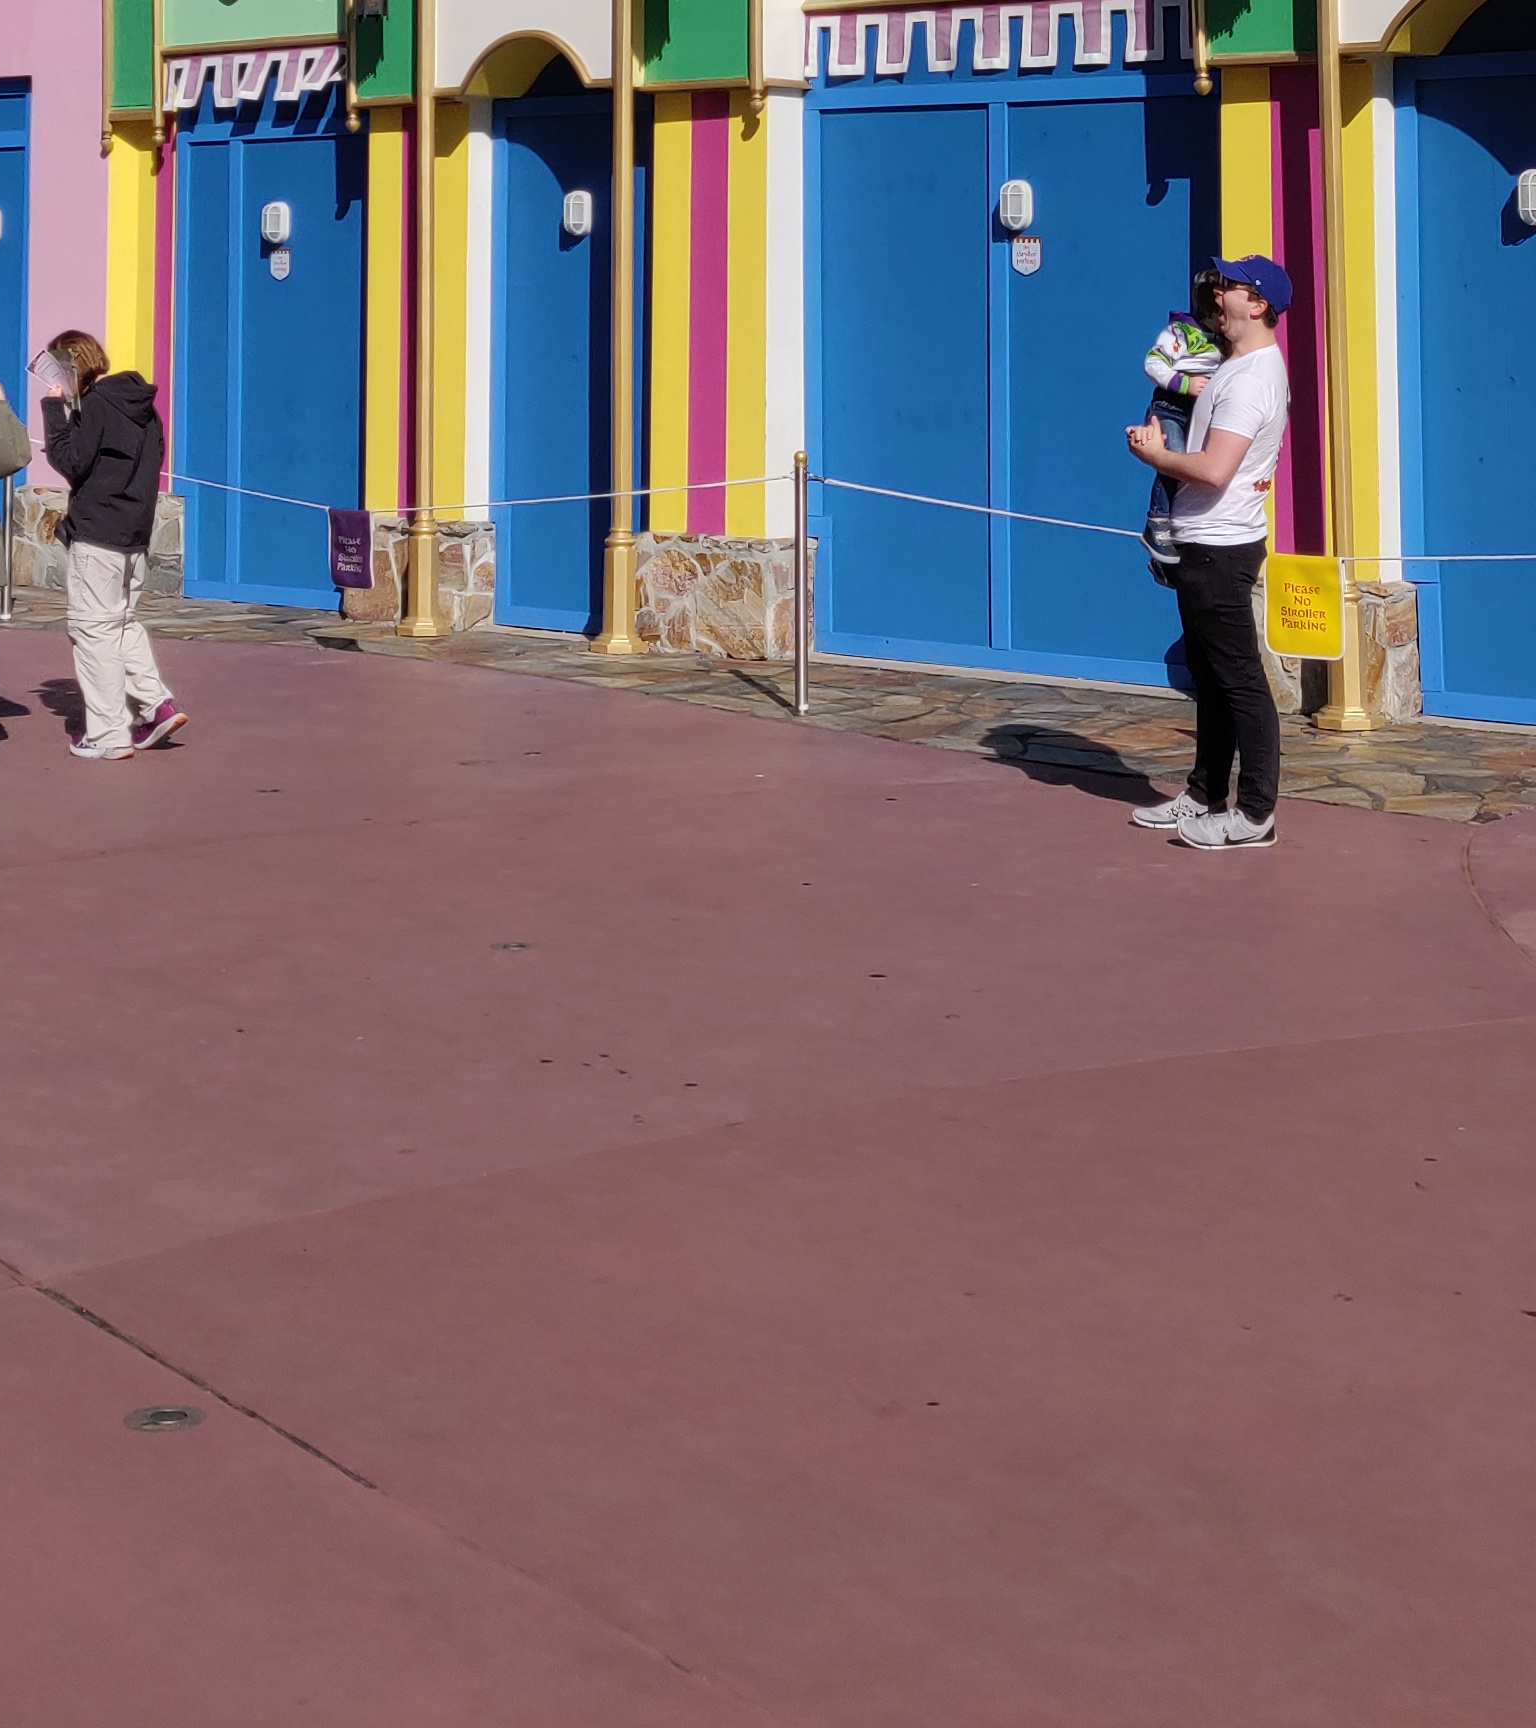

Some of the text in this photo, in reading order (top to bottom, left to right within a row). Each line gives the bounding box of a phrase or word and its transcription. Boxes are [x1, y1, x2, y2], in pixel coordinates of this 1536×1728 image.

[1283, 582, 1321, 595] Please
[1294, 595, 1311, 607] No
[1281, 606, 1326, 619] Stroller
[1281, 618, 1327, 633] Parking
